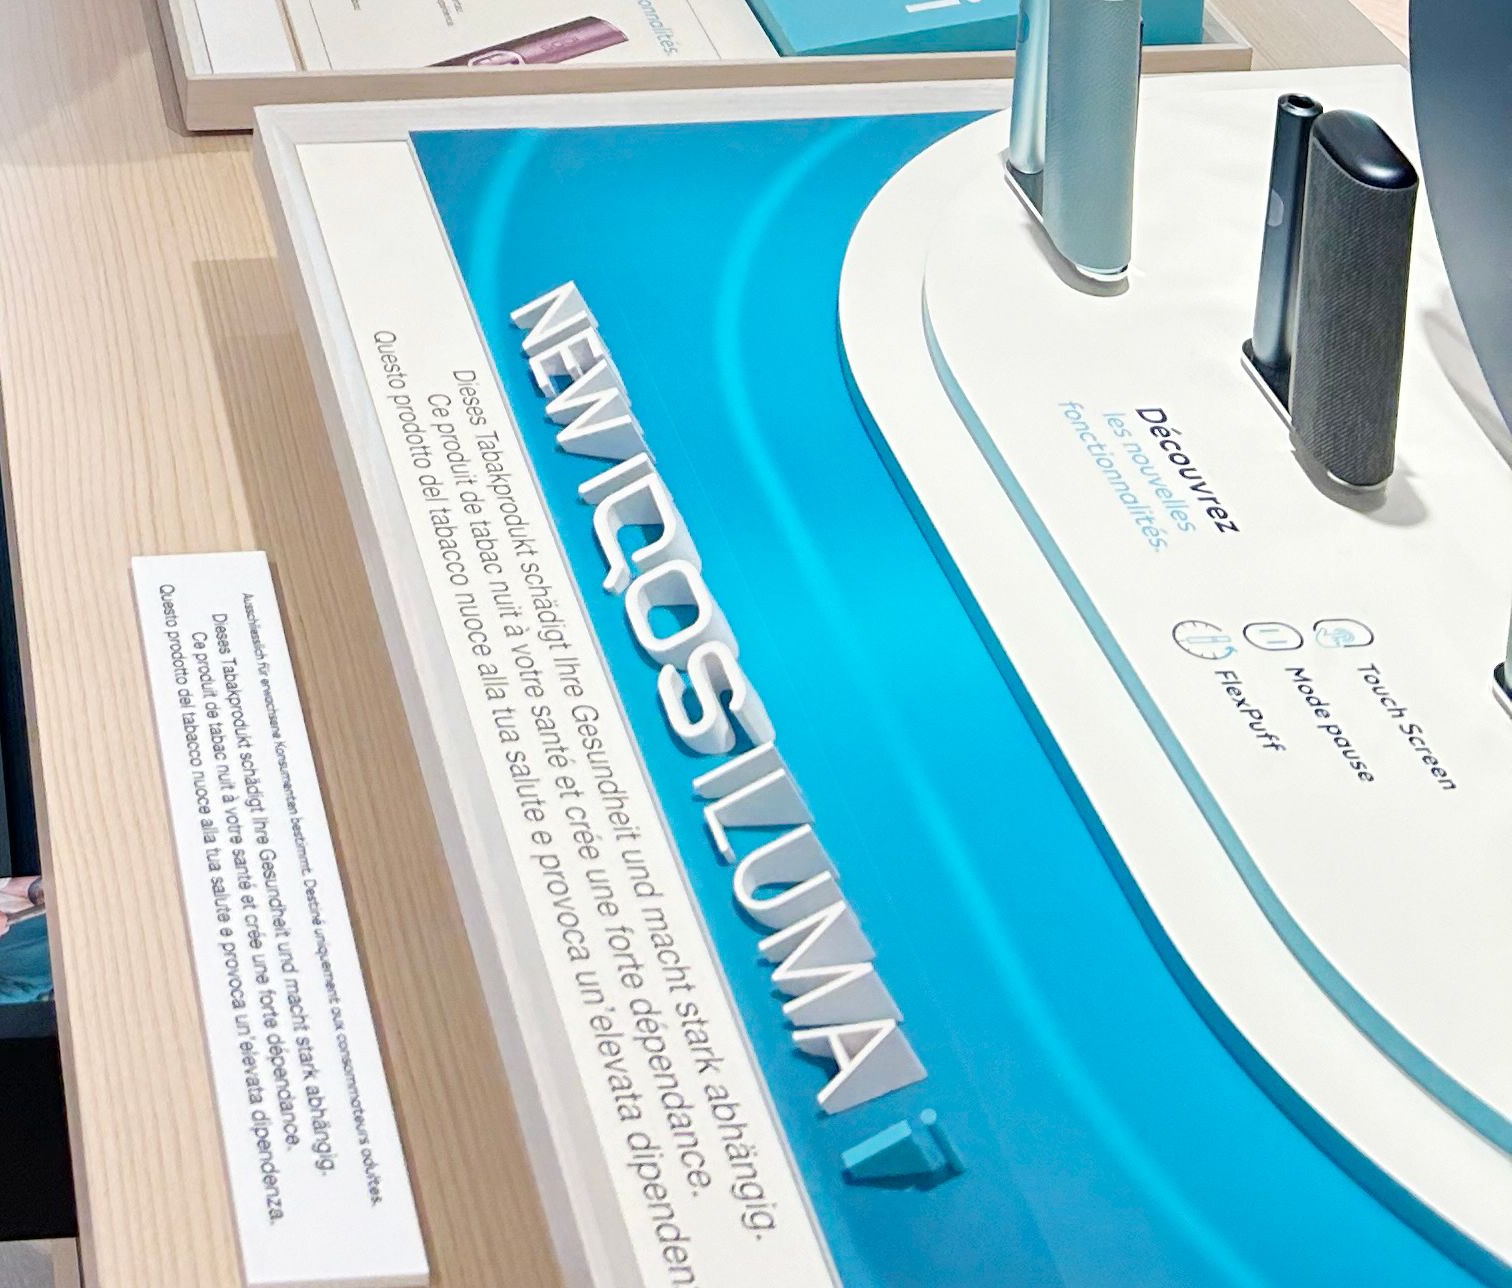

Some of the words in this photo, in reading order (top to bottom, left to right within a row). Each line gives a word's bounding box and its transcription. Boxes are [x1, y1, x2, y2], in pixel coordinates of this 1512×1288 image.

[373, 330, 406, 391] Questo
[510, 280, 652, 462] NEW
[389, 394, 432, 469] prodotto
[427, 393, 450, 419] Ce
[432, 423, 474, 488] produit
[1058, 400, 1169, 553] fonctionnalités.
[1103, 411, 1129, 438] les
[1128, 442, 1196, 533] nouvelles
[1135, 407, 1239, 534] Découvrez
[417, 473, 441, 503] del
[459, 489, 482, 516] de
[429, 506, 469, 587] tabacco
[471, 519, 502, 575] tabac
[159, 584, 178, 627] Questo
[455, 593, 492, 658] nuoce
[489, 579, 518, 617] nuit
[578, 452, 774, 754] IQOS
[166, 630, 187, 686] prodotto
[211, 614, 232, 654] Dieses
[503, 621, 524, 637] à
[194, 653, 218, 700] produit
[477, 662, 507, 702] alla
[514, 642, 545, 698] votre
[221, 659, 251, 748] Tabakprodukt
[491, 705, 518, 744] tua
[1214, 669, 1286, 752] FlexPuff
[1285, 666, 1331, 719] Mode
[1322, 725, 1375, 784] pause
[1357, 662, 1407, 719] Touch
[1399, 724, 1457, 791] Screen
[182, 711, 202, 767] tabacco
[208, 721, 227, 760] tabac
[532, 703, 571, 772] santé
[192, 770, 211, 815] nuoce
[240, 752, 265, 813] schädigt
[452, 369, 488, 425] Dieses
[475, 430, 535, 559] Tabakprodukt
[521, 562, 568, 651] schädigt
[552, 655, 584, 699] Ihre
[571, 705, 640, 840] Gesundheit
[620, 848, 657, 898] und
[642, 904, 692, 994] macht
[675, 1001, 721, 1075] stark
[704, 1083, 777, 1243] abhängig.
[506, 750, 545, 823] salute
[556, 774, 580, 801] et
[225, 808, 243, 844] votre
[530, 829, 553, 847] e
[565, 805, 600, 861] crée
[211, 876, 231, 923] salute
[232, 847, 253, 891] santé
[258, 849, 291, 937] Gesundheit
[585, 867, 619, 917] une
[539, 853, 590, 965] provoca
[693, 740, 926, 1114] ILUMA
[219, 942, 248, 1009] provoca
[276, 941, 296, 973] und
[605, 924, 644, 991] forte
[259, 988, 278, 1030] forte
[284, 978, 310, 1033] macht
[234, 1013, 262, 1106] un'elevata
[295, 1035, 320, 1079] stark
[575, 970, 643, 1124] un'elevata
[267, 1033, 300, 1151] dépendance.
[630, 997, 712, 1198] dépendance.
[305, 1084, 336, 1176] abhängig.
[251, 1109, 284, 1226] dipendenza.
[626, 1130, 696, 1288] dipenden
